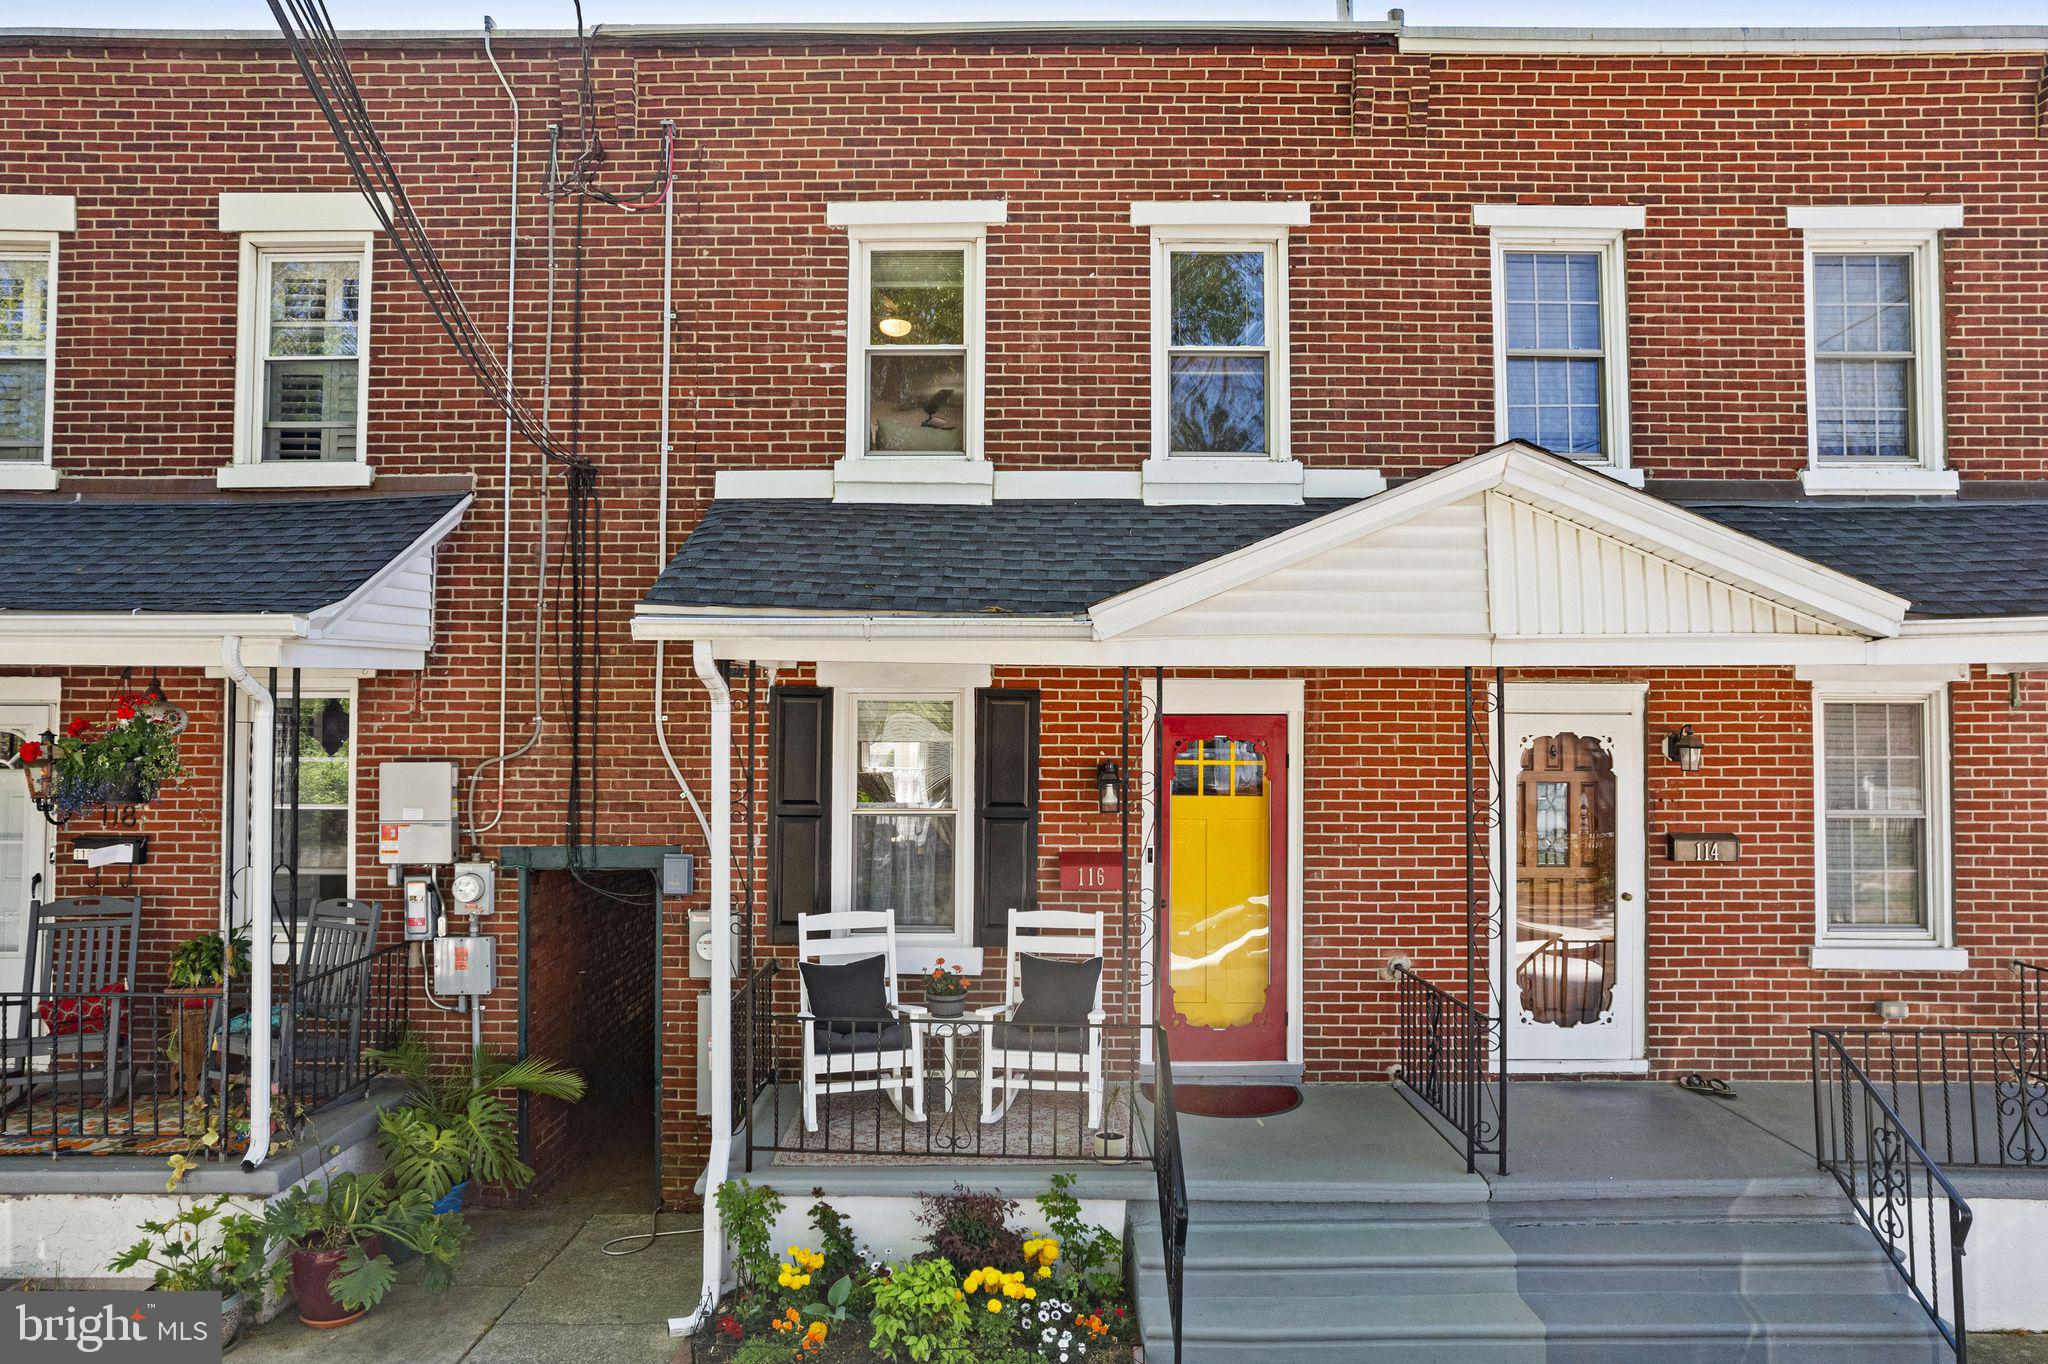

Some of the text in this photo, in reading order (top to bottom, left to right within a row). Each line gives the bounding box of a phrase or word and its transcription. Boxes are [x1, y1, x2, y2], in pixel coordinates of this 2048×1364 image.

[102, 804, 136, 827] 118
[1696, 842, 1719, 861] 114
[1078, 867, 1105, 886] 116
